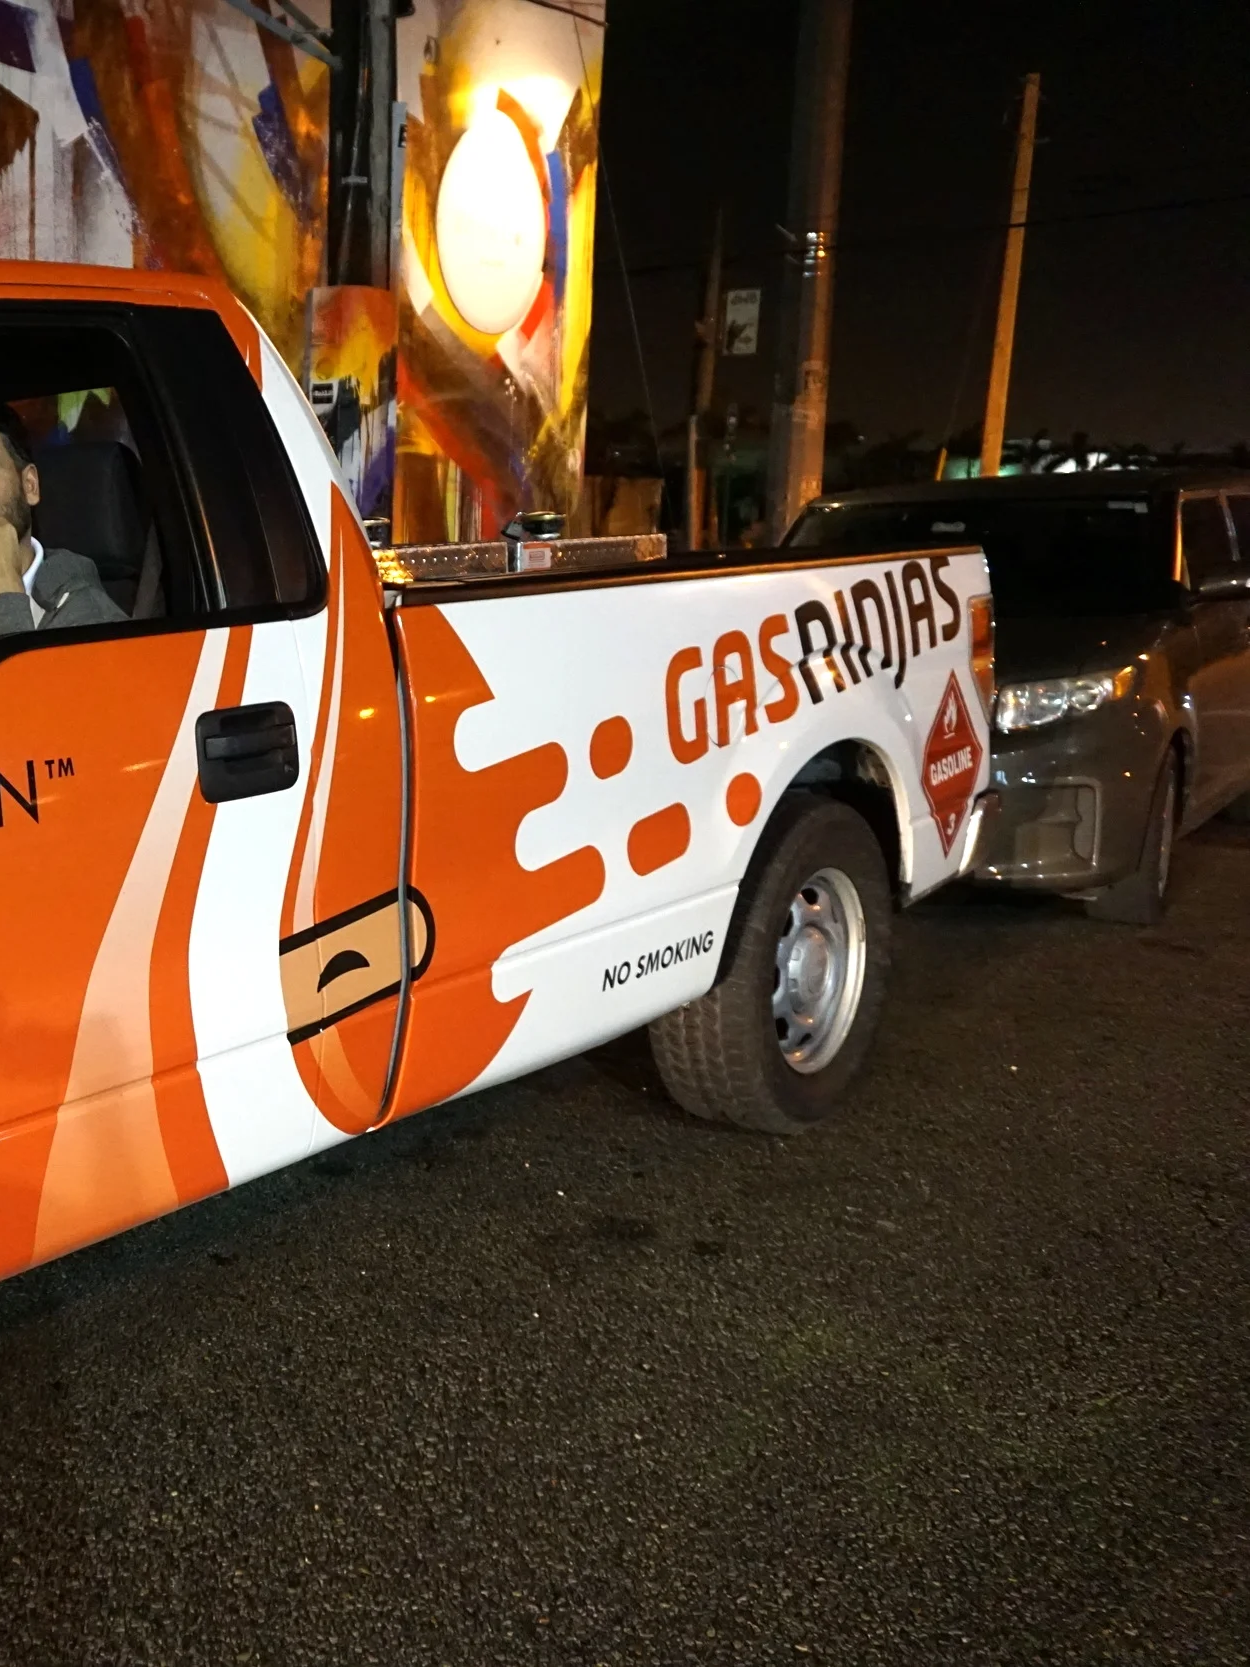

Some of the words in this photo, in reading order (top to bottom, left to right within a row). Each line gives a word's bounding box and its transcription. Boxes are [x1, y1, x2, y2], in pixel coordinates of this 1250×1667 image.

[930, 746, 974, 786] GASOLINE
[946, 814, 955, 835] 3
[602, 961, 631, 992] NO
[635, 930, 714, 979] SMOKING
